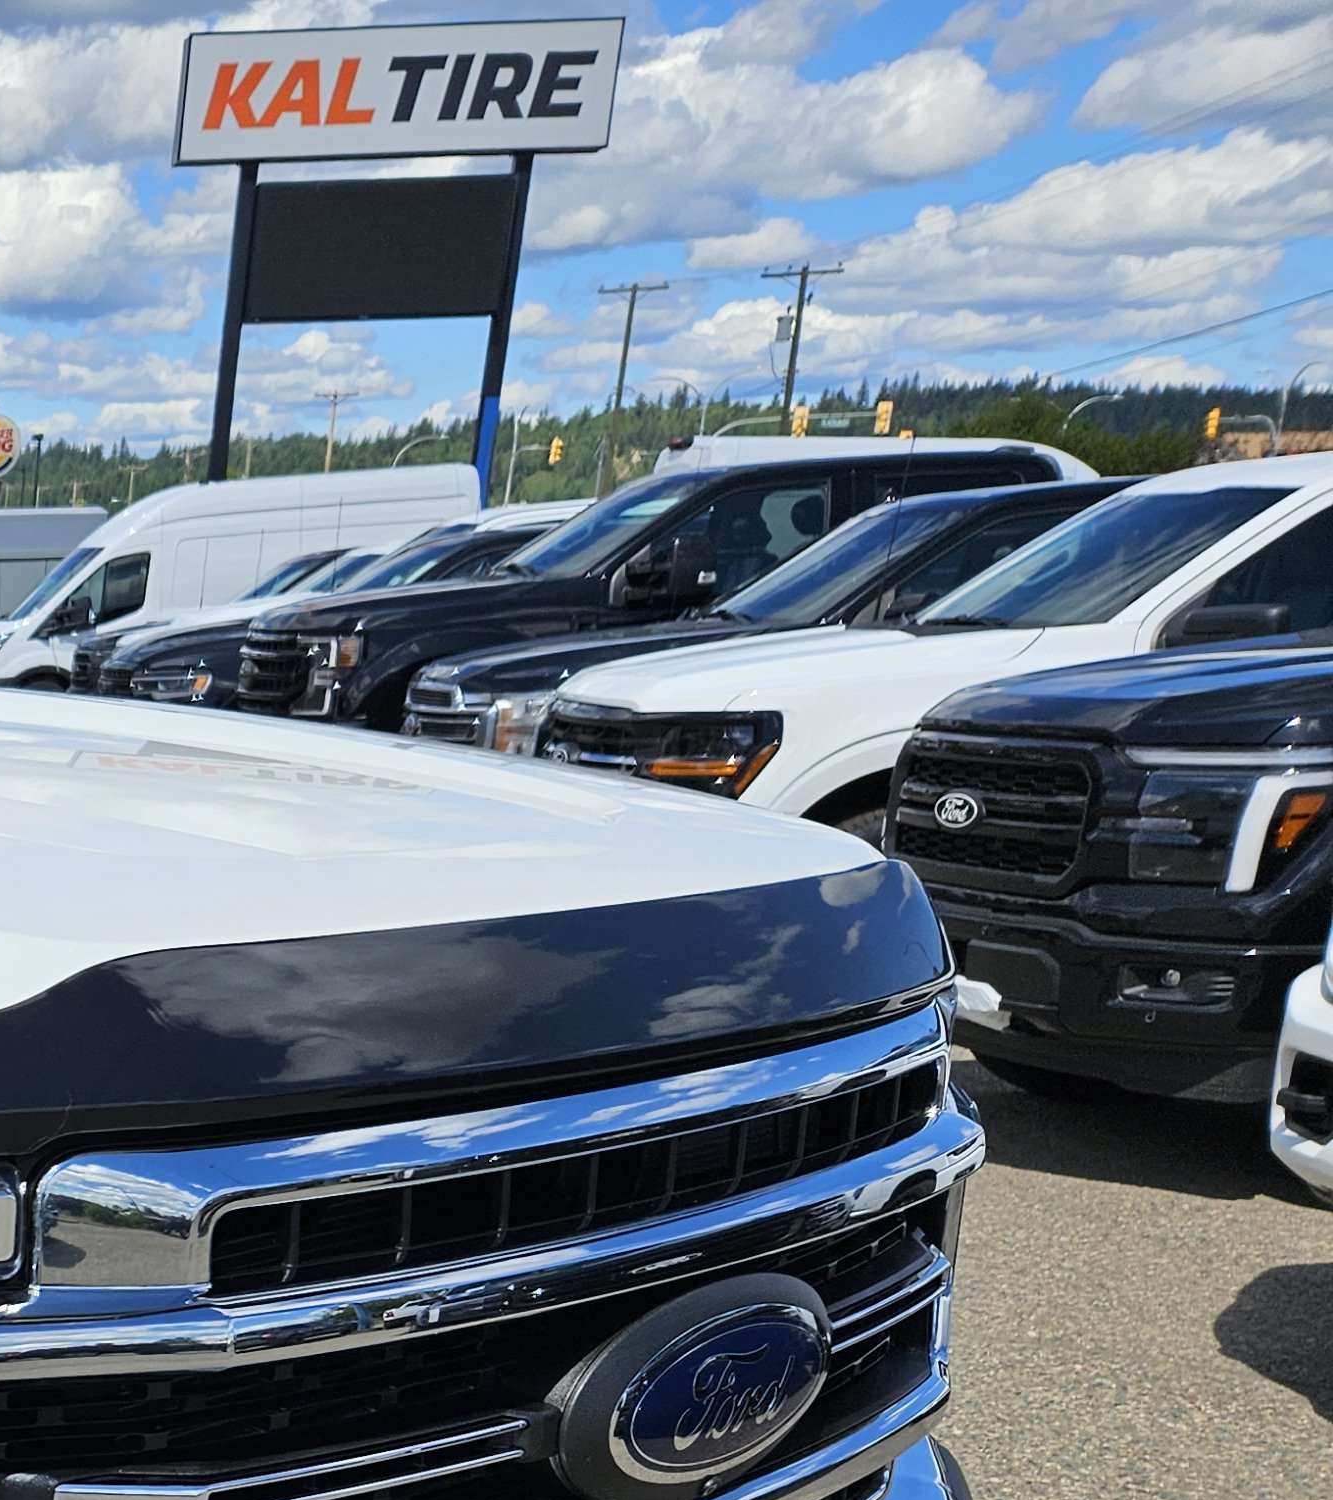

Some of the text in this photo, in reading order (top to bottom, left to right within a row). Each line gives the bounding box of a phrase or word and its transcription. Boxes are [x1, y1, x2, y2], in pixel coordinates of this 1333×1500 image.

[201, 49, 600, 131] KAL TIRE
[941, 799, 970, 822] Ford
[673, 1343, 796, 1451] Ford
